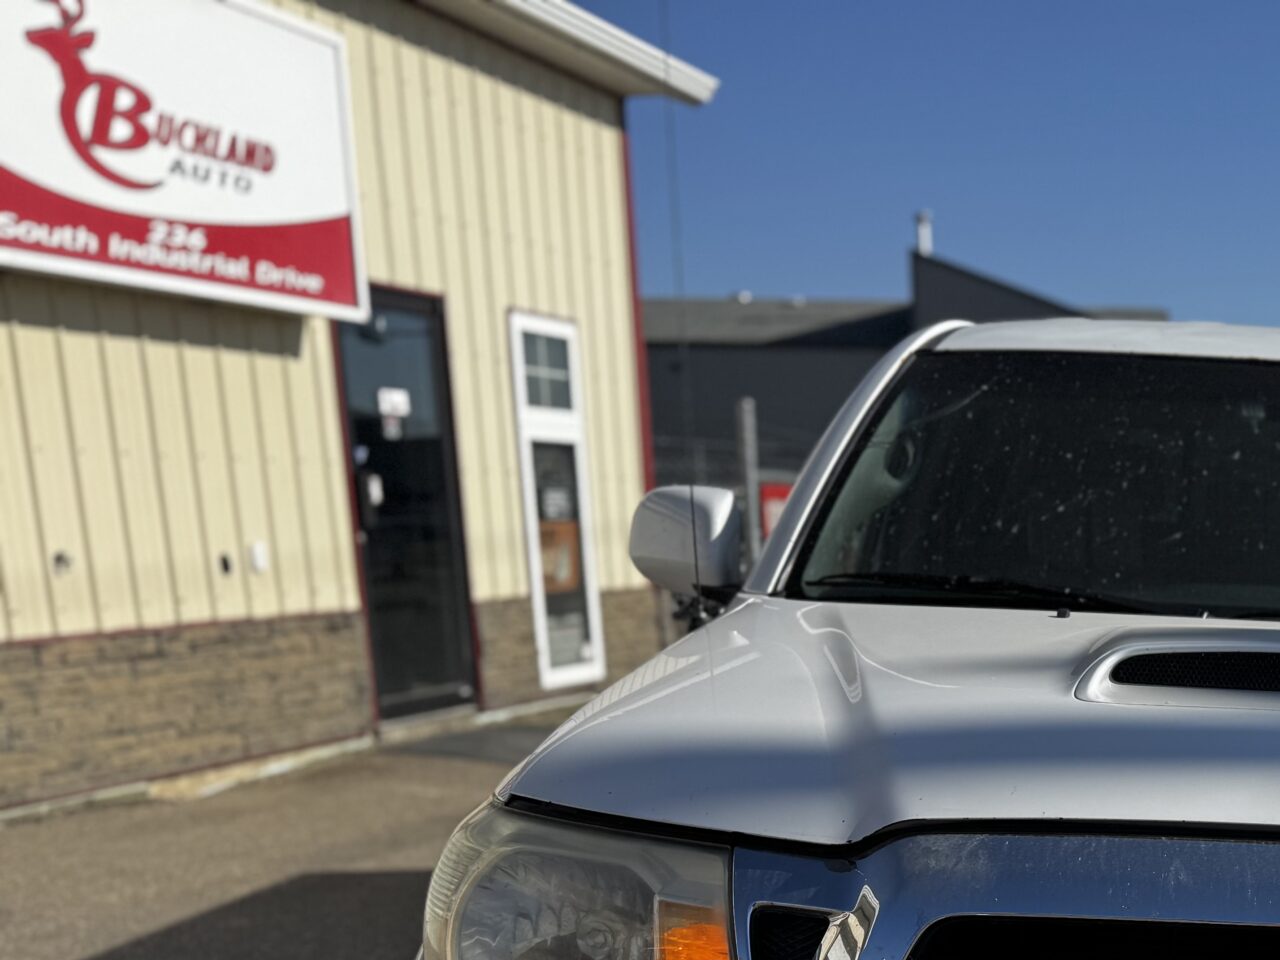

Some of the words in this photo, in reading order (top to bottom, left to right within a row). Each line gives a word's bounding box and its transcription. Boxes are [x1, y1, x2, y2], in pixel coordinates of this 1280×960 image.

[168, 157, 253, 194] AUTO
[0, 210, 99, 256] South
[107, 231, 250, 283] Industrial
[254, 258, 326, 295] Drive
[147, 218, 208, 250] 236
